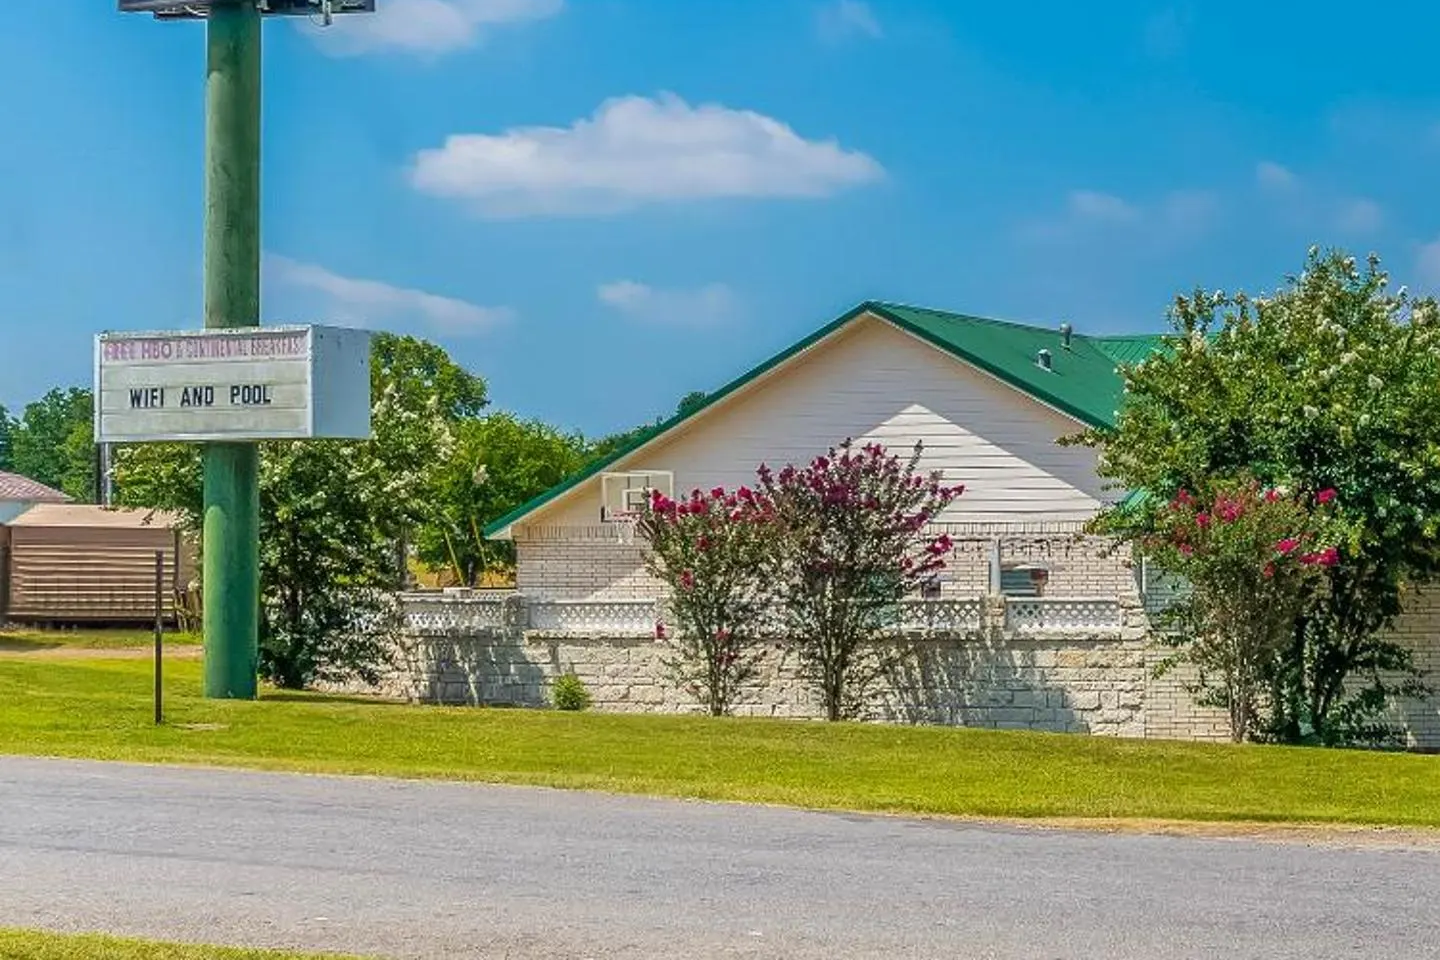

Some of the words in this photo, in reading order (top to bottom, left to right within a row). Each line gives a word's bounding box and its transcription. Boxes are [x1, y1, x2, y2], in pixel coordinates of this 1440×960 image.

[141, 340, 171, 359] HBO
[129, 386, 164, 408] WIFI
[180, 385, 214, 407] AND
[230, 384, 271, 404] POOL
